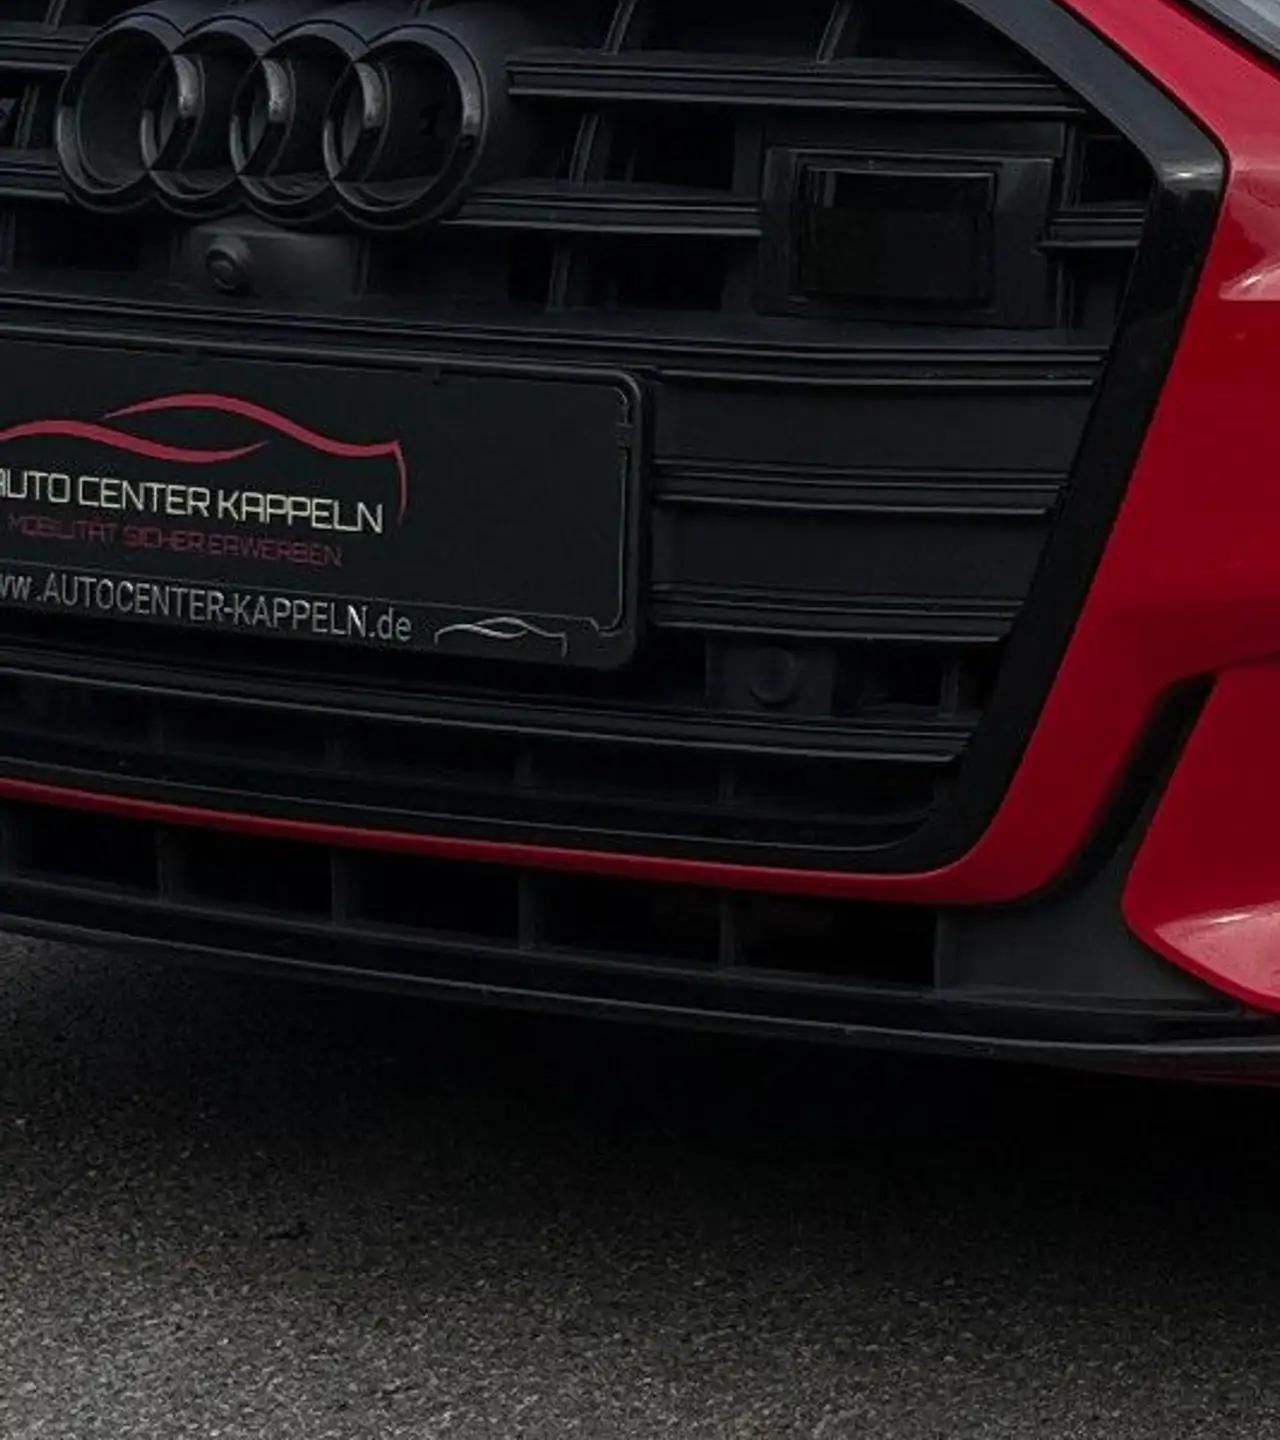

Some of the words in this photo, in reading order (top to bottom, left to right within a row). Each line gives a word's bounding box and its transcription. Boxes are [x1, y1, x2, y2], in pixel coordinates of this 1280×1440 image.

[78, 475, 211, 519] CENTER
[217, 488, 384, 535] KAPPELN
[207, 532, 344, 569] ERWERBEN
